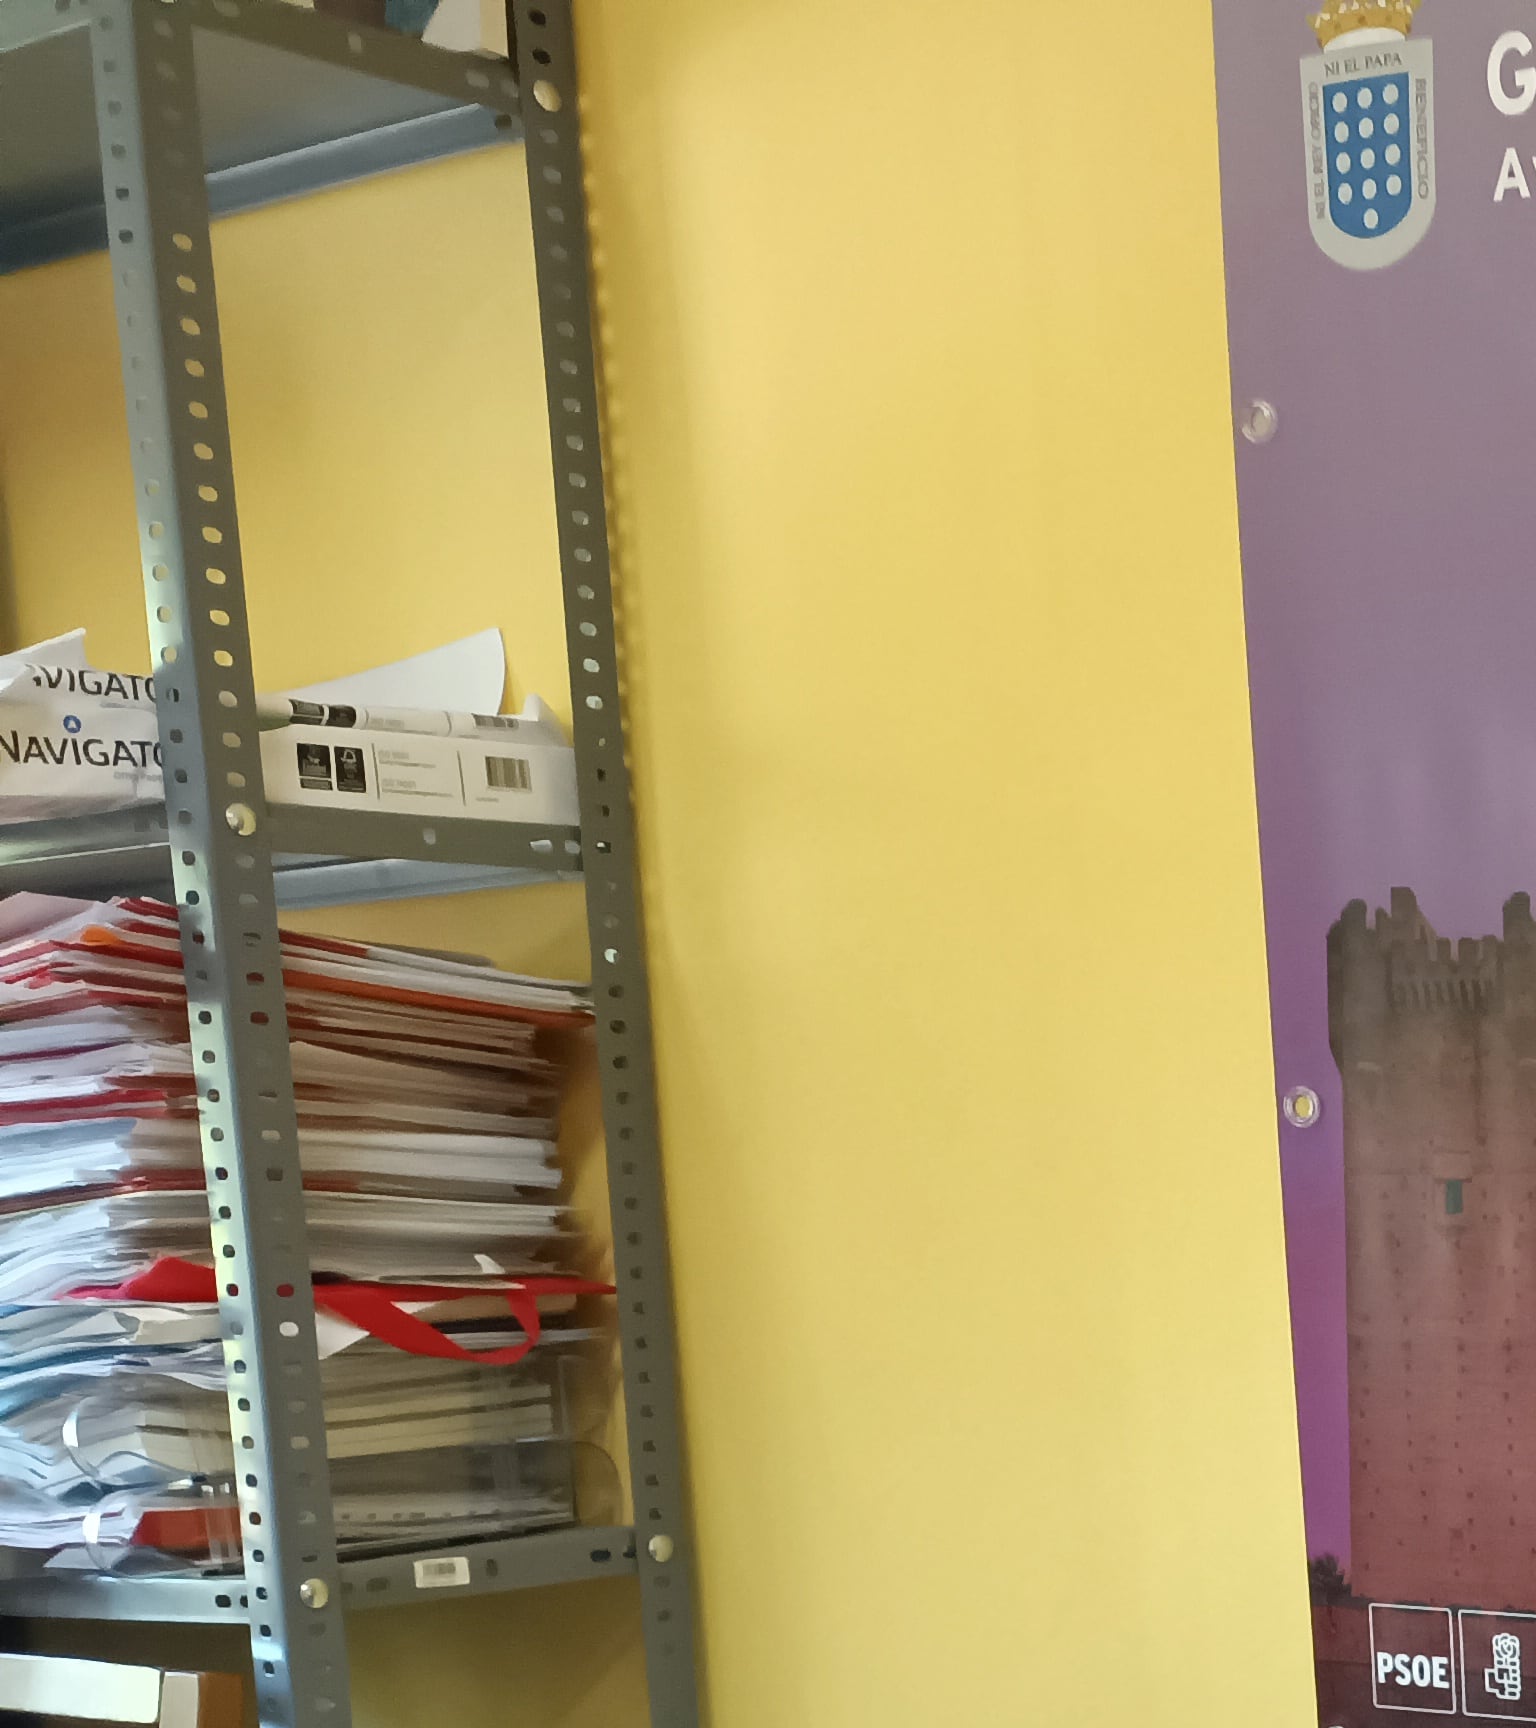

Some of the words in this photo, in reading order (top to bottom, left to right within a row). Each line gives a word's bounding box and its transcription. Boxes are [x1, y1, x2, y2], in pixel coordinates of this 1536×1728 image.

[1323, 59, 1340, 78] NI
[1344, 58, 1361, 74] EL
[33, 664, 157, 703] VIGAT
[1376, 1650, 1451, 1690] PSOE
